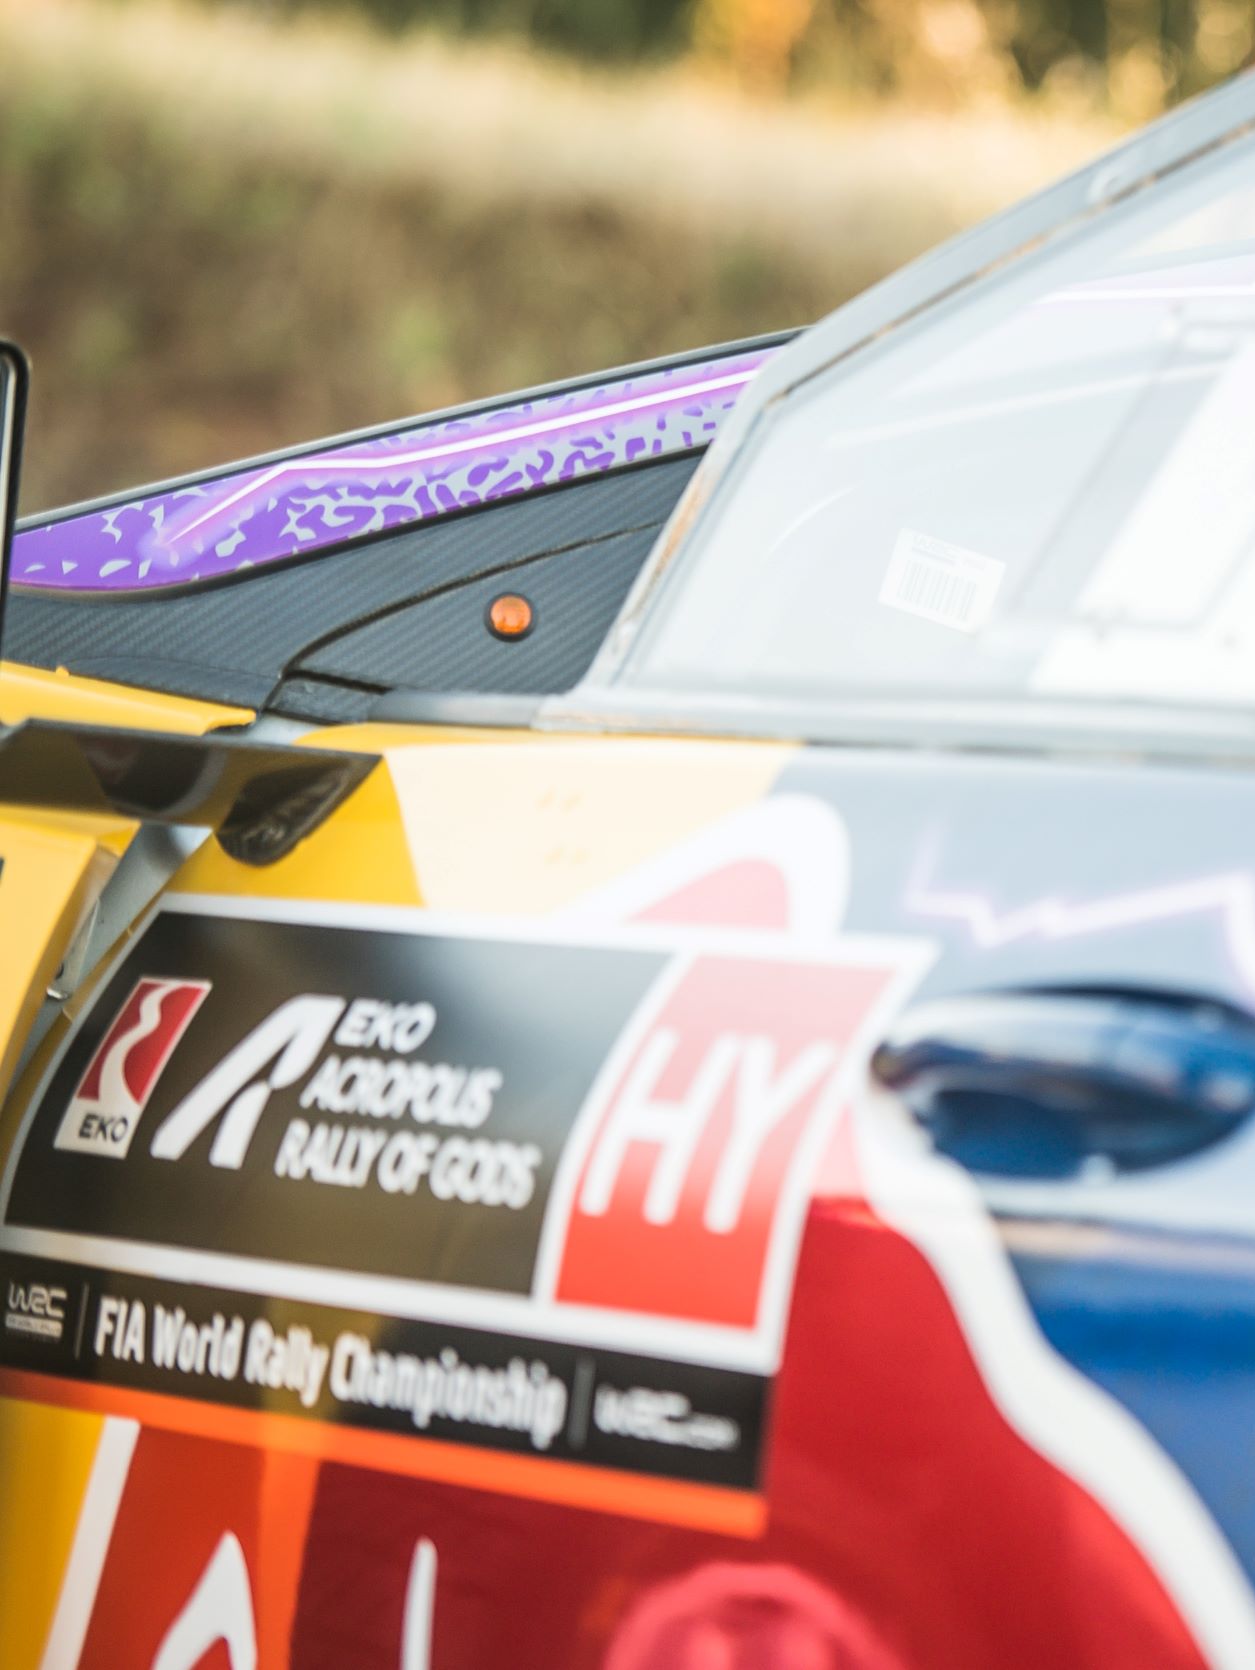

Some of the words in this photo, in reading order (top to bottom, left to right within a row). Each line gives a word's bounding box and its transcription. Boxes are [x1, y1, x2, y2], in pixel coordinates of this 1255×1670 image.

[336, 997, 438, 1054] EKO
[79, 1113, 129, 1144] EKO
[299, 1055, 504, 1130] ACROPOLIS
[274, 1117, 386, 1189] RALLY
[376, 1130, 441, 1196] OF
[427, 1134, 542, 1211] GODS
[579, 1027, 834, 1235] HY
[7, 1282, 68, 1319] WRC
[94, 1295, 146, 1364] FIA
[152, 1304, 246, 1382] World
[243, 1318, 330, 1409] Rally
[329, 1332, 568, 1450] Championship
